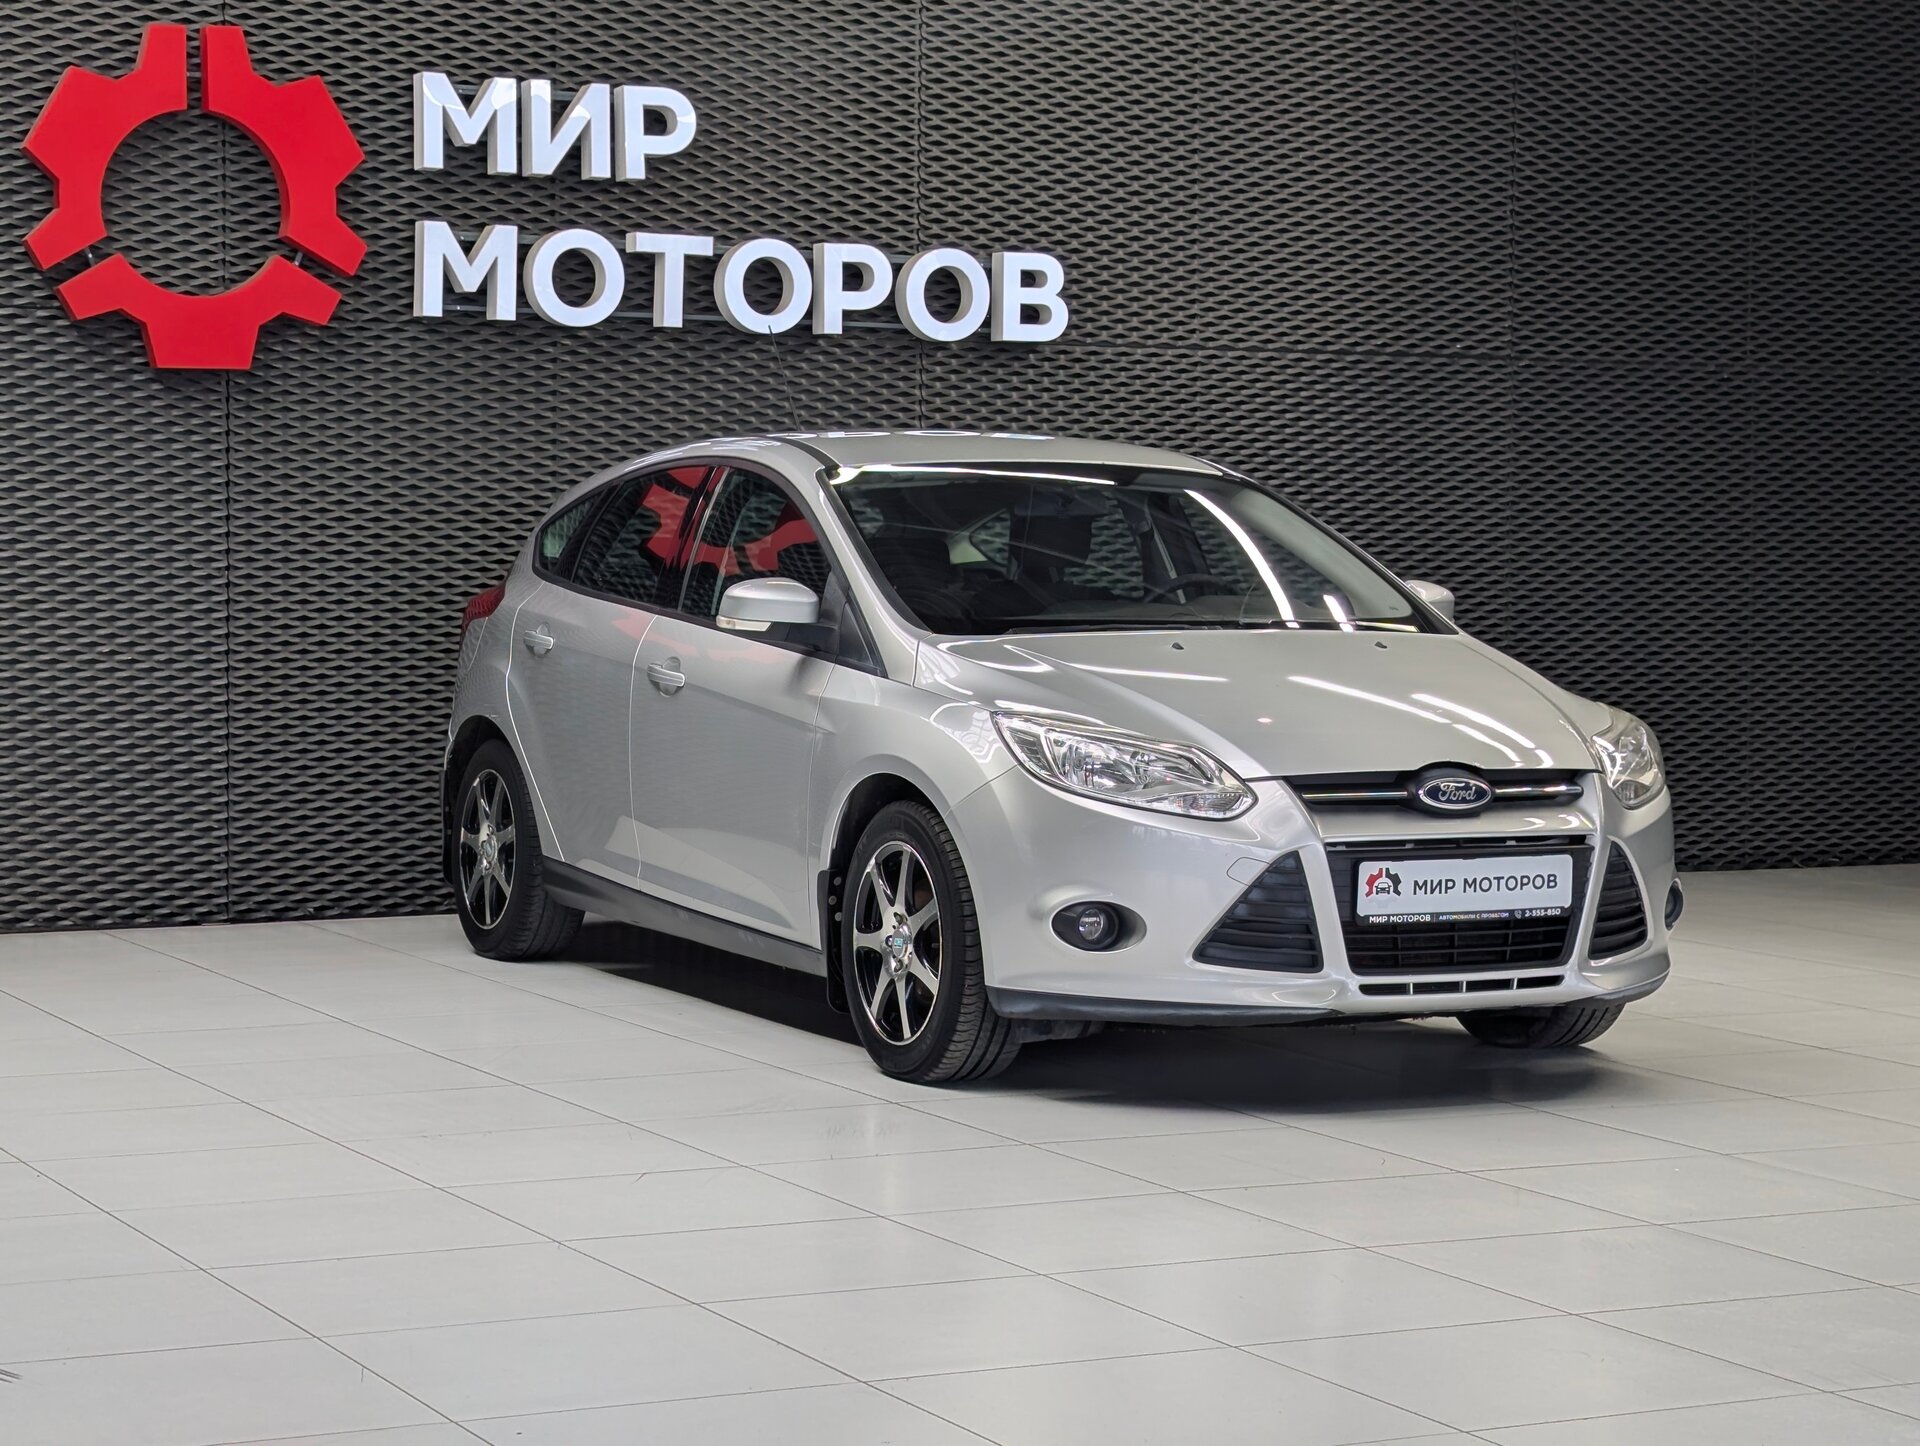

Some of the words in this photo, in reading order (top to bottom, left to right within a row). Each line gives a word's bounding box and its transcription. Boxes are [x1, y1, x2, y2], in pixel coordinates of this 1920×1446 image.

[413, 71, 697, 182] МИР
[413, 220, 1069, 342] МОТОРОВ
[1438, 782, 1477, 801] Ford
[1413, 878, 1456, 895] МИР
[1463, 873, 1558, 893] МОТОРОВ
[1369, 915, 1388, 923] МИР
[1389, 914, 1431, 923] МОТОРОВ
[1525, 908, 1561, 917] 2-555-850
